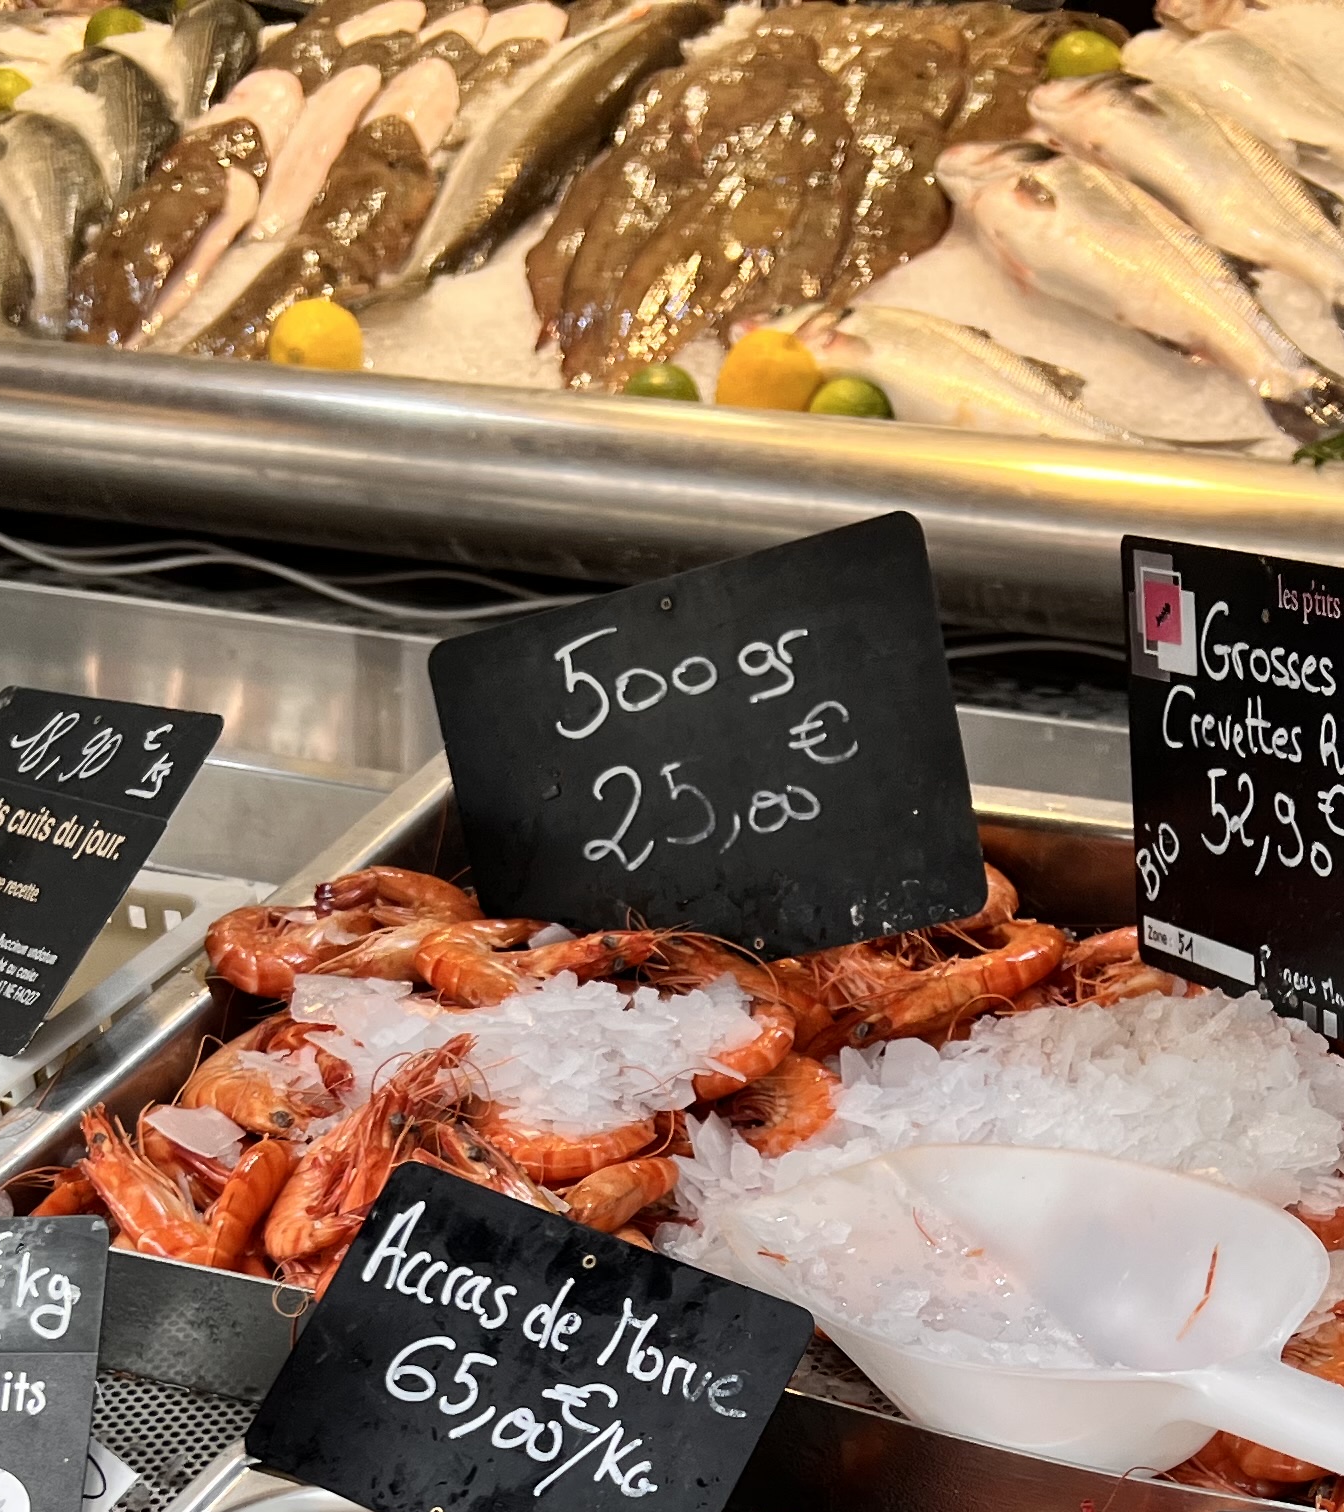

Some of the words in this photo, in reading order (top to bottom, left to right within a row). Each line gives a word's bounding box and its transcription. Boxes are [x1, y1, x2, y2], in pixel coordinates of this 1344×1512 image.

[1277, 574, 1299, 612] les
[1303, 580, 1342, 625] p'tits
[553, 626, 719, 740] 500
[1200, 601, 1337, 696] Grosses
[1162, 685, 1302, 763] Crevettes
[6, 805, 56, 842] cuits
[53, 818, 80, 849] du
[72, 819, 127, 861] jour.
[583, 760, 822, 872] 25,00
[1147, 924, 1168, 946] Zone
[361, 1201, 517, 1330] Accras
[522, 1277, 583, 1351] de
